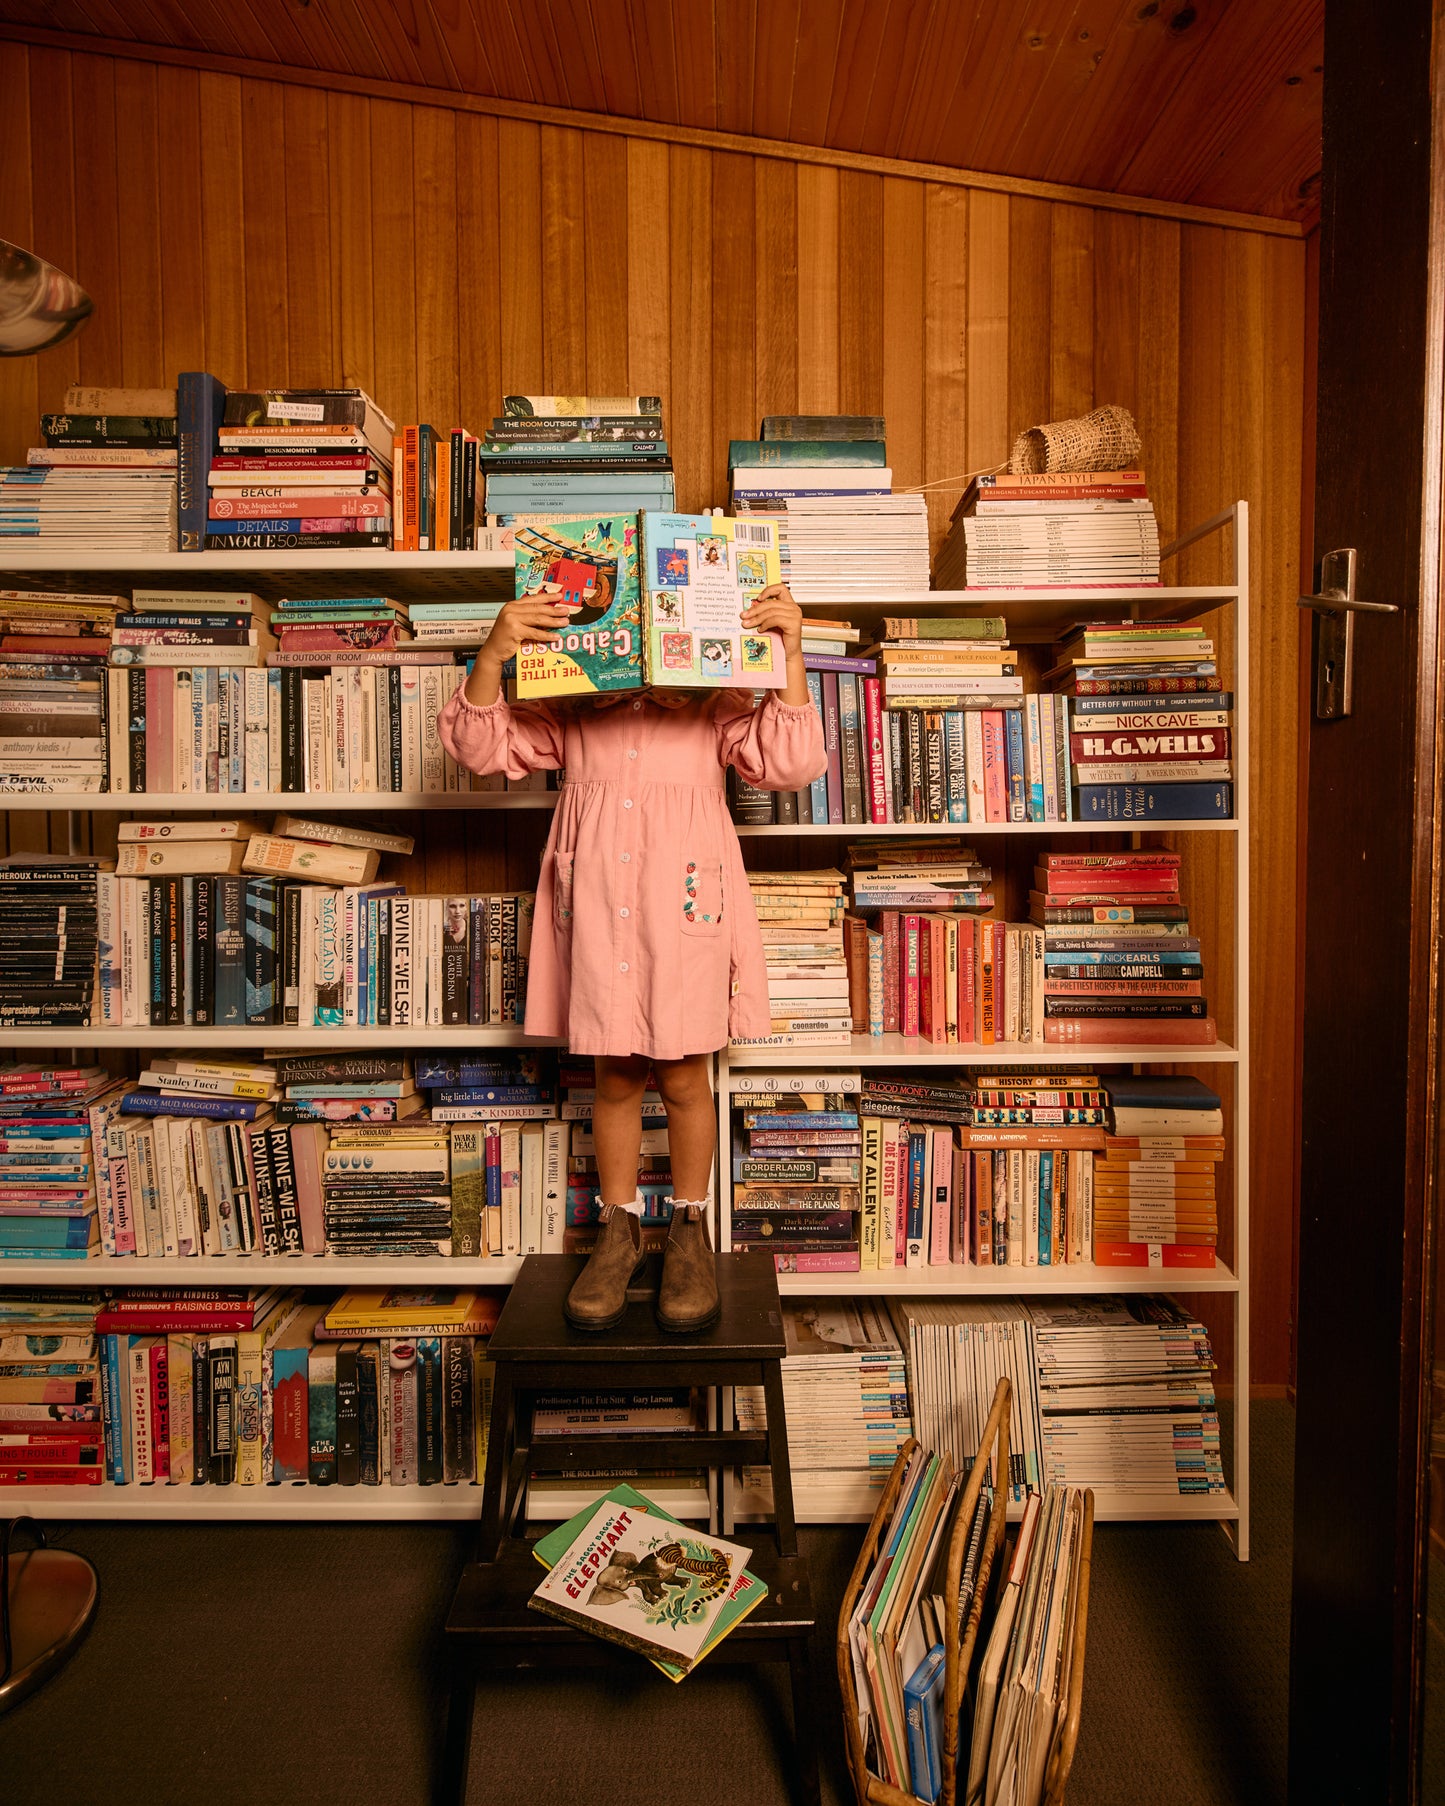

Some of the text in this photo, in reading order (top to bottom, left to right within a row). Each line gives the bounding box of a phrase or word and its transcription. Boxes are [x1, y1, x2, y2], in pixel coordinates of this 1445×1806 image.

[1019, 474, 1096, 485] JAPAN STYLE
[241, 488, 282, 497] BEACH
[984, 488, 1017, 496] BRINGING
[237, 521, 289, 532] DETAILS
[211, 534, 297, 548] IN VOGUE 50
[136, 617, 157, 625] SECRET
[178, 617, 202, 625] WHALES
[521, 628, 632, 657] Caboose
[276, 652, 419, 662] THE OUTDOOR ROOM JAMIE DURIE
[520, 657, 544, 669] RED
[521, 665, 584, 681] THE LITTLE
[247, 672, 257, 717] GREGORY
[257, 673, 266, 717] PHILIPPA
[1082, 701, 1107, 709] BETTER
[828, 707, 838, 750] sunbathing
[843, 684, 856, 770] HANNAH KENT
[1116, 714, 1199, 729] NICK CAVE
[392, 712, 400, 749] VIETNAM
[1042, 697, 1054, 795] BRET EASTON ELLIS
[871, 753, 885, 805] WETLANDS
[928, 733, 941, 810] STEPHEN KING
[345, 894, 353, 910] NOT
[197, 881, 208, 940] GREAT SEX
[153, 887, 161, 1002] NEVER ALONE ELIZABETH HAYNES
[323, 898, 335, 981] SAGA LAND
[982, 924, 993, 963] Trainspotting
[346, 954, 353, 966] OF
[395, 898, 410, 1025] IRVINE WELSH
[447, 955, 455, 1001] GARDENIA
[1120, 965, 1163, 978] CAMPBELL
[983, 976, 992, 1032] IRVINE WELSH
[6, 1084, 37, 1093] Spanish
[157, 1075, 254, 1094] Stanley Tucci Taste
[868, 1082, 898, 1094] BLOOD
[900, 1086, 930, 1097] MONEY
[999, 1078, 1033, 1086] HISTORY
[440, 1091, 484, 1102] big little lies
[489, 1108, 535, 1118] KINDRED
[864, 1101, 901, 1114] sleepers
[110, 1132, 119, 1147] Girl
[116, 1131, 125, 1152] Funny
[900, 1149, 905, 1157] Do
[865, 1129, 878, 1215] LILY ALLEN
[884, 1160, 895, 1197] FOSTER
[115, 1164, 129, 1230] Nick Hornby
[250, 1130, 280, 1258] IRVINE WELSH
[270, 1127, 300, 1254] IRVINE WELSH
[739, 1201, 780, 1209] IGGULDEN
[799, 1201, 840, 1209] THE PLAINS
[899, 1196, 904, 1205] Go
[175, 1302, 212, 1311] RAISING
[215, 1302, 241, 1311] BOYS
[429, 1322, 489, 1334] AUSTRALIA
[216, 1361, 230, 1375] AYN
[214, 1377, 232, 1389] RAND
[450, 1347, 462, 1408] PASSAGE
[217, 1403, 230, 1451] FOUNTAINHEAD
[310, 1445, 335, 1454] SLAP
[577, 1470, 609, 1478] ROLLING
[562, 1566, 578, 1584] THE
[576, 1541, 598, 1567] SAGGY
[595, 1516, 616, 1543] BAGGY
[564, 1510, 634, 1600] ELEPHANT
